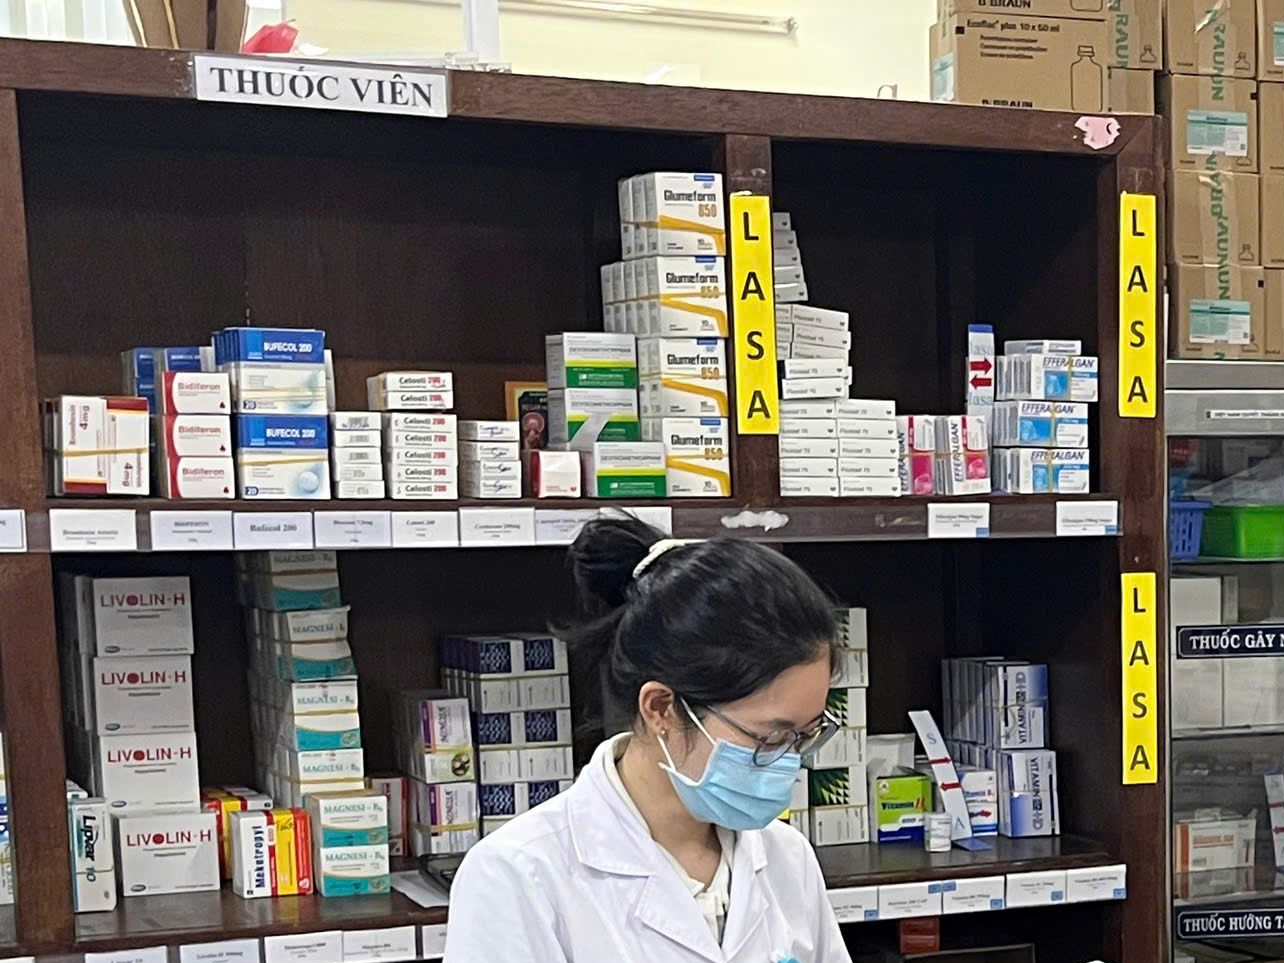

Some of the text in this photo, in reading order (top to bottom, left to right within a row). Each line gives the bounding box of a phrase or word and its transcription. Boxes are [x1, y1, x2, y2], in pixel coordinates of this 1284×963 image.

[350, 73, 433, 108] VIÊN
[664, 189, 717, 202] Glumeform
[667, 354, 720, 367] Glumeform
[671, 434, 723, 446] Glumeform
[1189, 628, 1241, 649] THUỐC
[1244, 630, 1276, 649] GÂY
[1183, 912, 1226, 932] THUỐC
[1229, 912, 1272, 932] HƯỚNG
